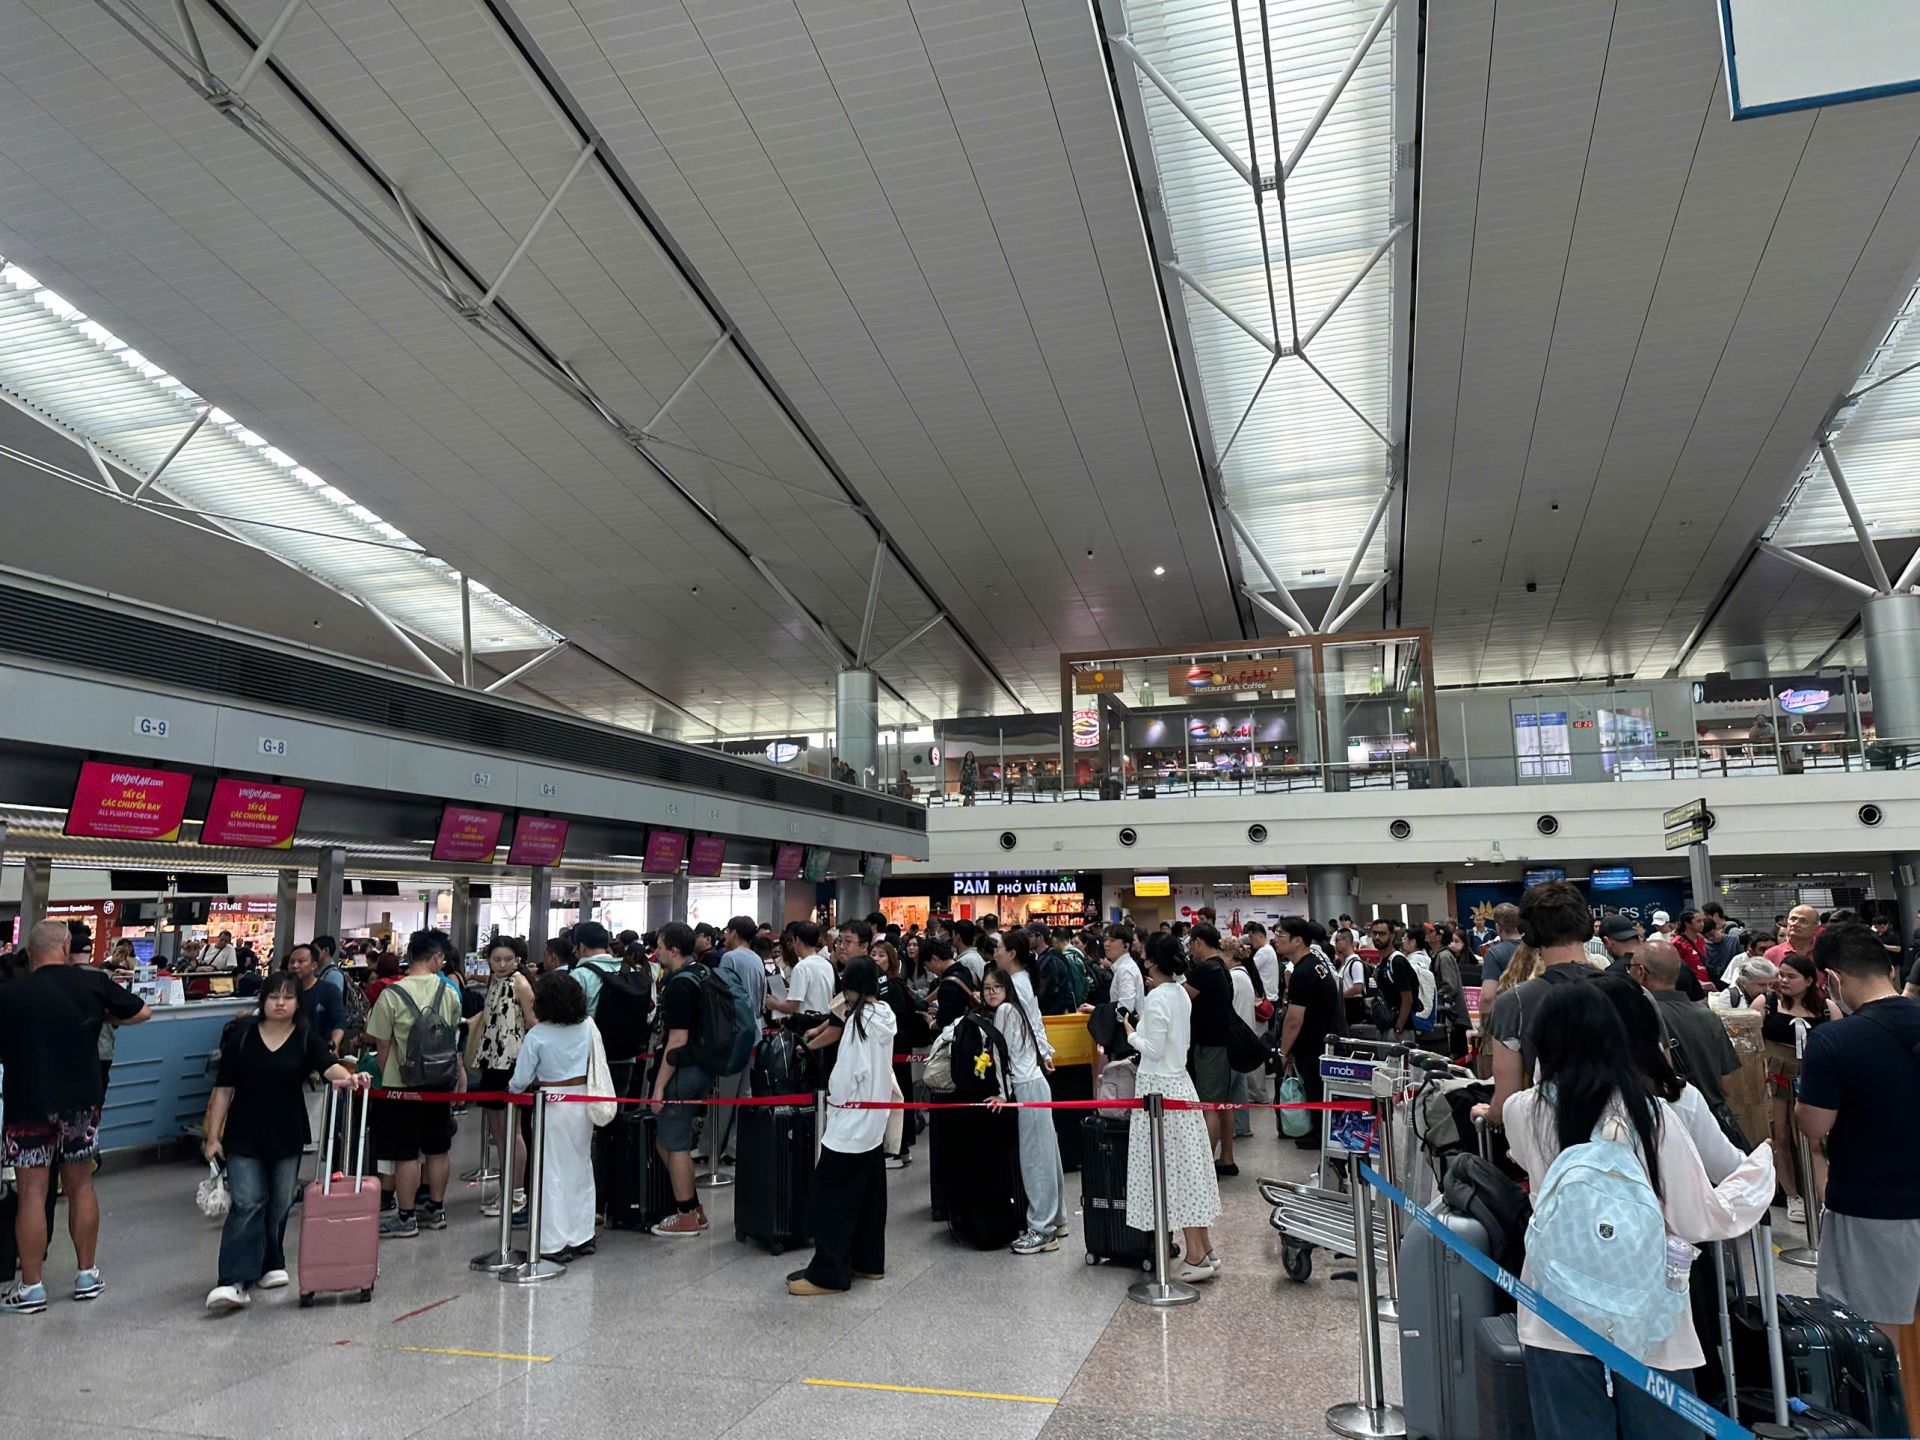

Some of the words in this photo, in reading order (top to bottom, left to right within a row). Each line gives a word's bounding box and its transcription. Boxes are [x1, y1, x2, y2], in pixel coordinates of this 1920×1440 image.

[1195, 684, 1233, 694] Restaurant
[1242, 682, 1267, 690] Coffee
[141, 719, 166, 735] G-9
[263, 739, 284, 754] G-8
[474, 773, 489, 785] G-7
[543, 783, 556, 796] G-6
[109, 810, 133, 818] FLIGHTS
[954, 880, 990, 894] PAM
[997, 880, 1022, 893] PHỞ
[1024, 880, 1047, 895] VIỆT
[1050, 882, 1077, 892] NAM
[905, 1054, 923, 1062] ACV
[387, 1090, 402, 1100] ACV
[1404, 1196, 1416, 1217] ACV
[1496, 1266, 1515, 1293] ACV
[1646, 1369, 1675, 1408] ACV
